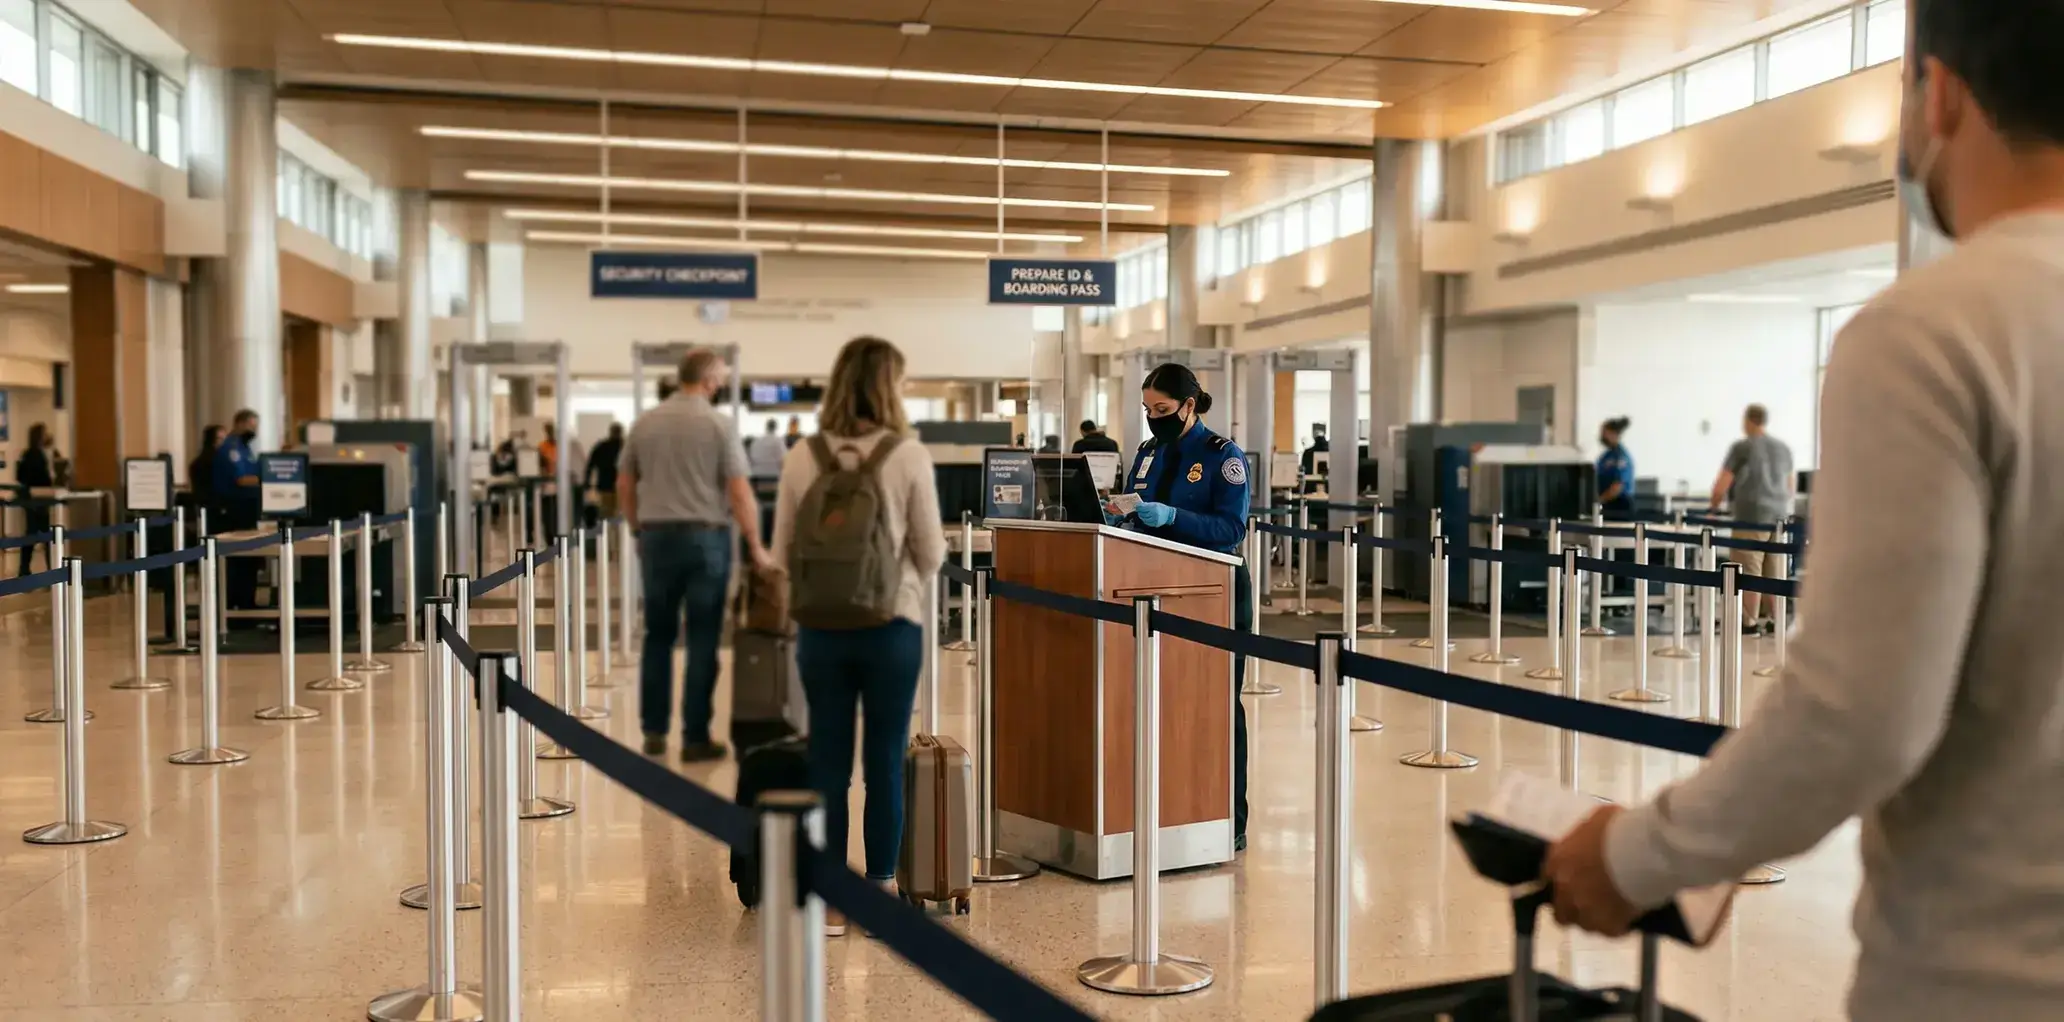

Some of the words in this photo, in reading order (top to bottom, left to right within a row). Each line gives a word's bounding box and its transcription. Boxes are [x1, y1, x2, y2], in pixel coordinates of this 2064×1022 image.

[601, 265, 662, 281] SECURITY
[665, 267, 748, 284] CHECKPOINT
[1011, 268, 1065, 281] PREPARE
[1067, 268, 1081, 282] ID
[1083, 269, 1094, 282] &
[1003, 282, 1068, 296] BOARDING
[1070, 283, 1102, 297] PASS
